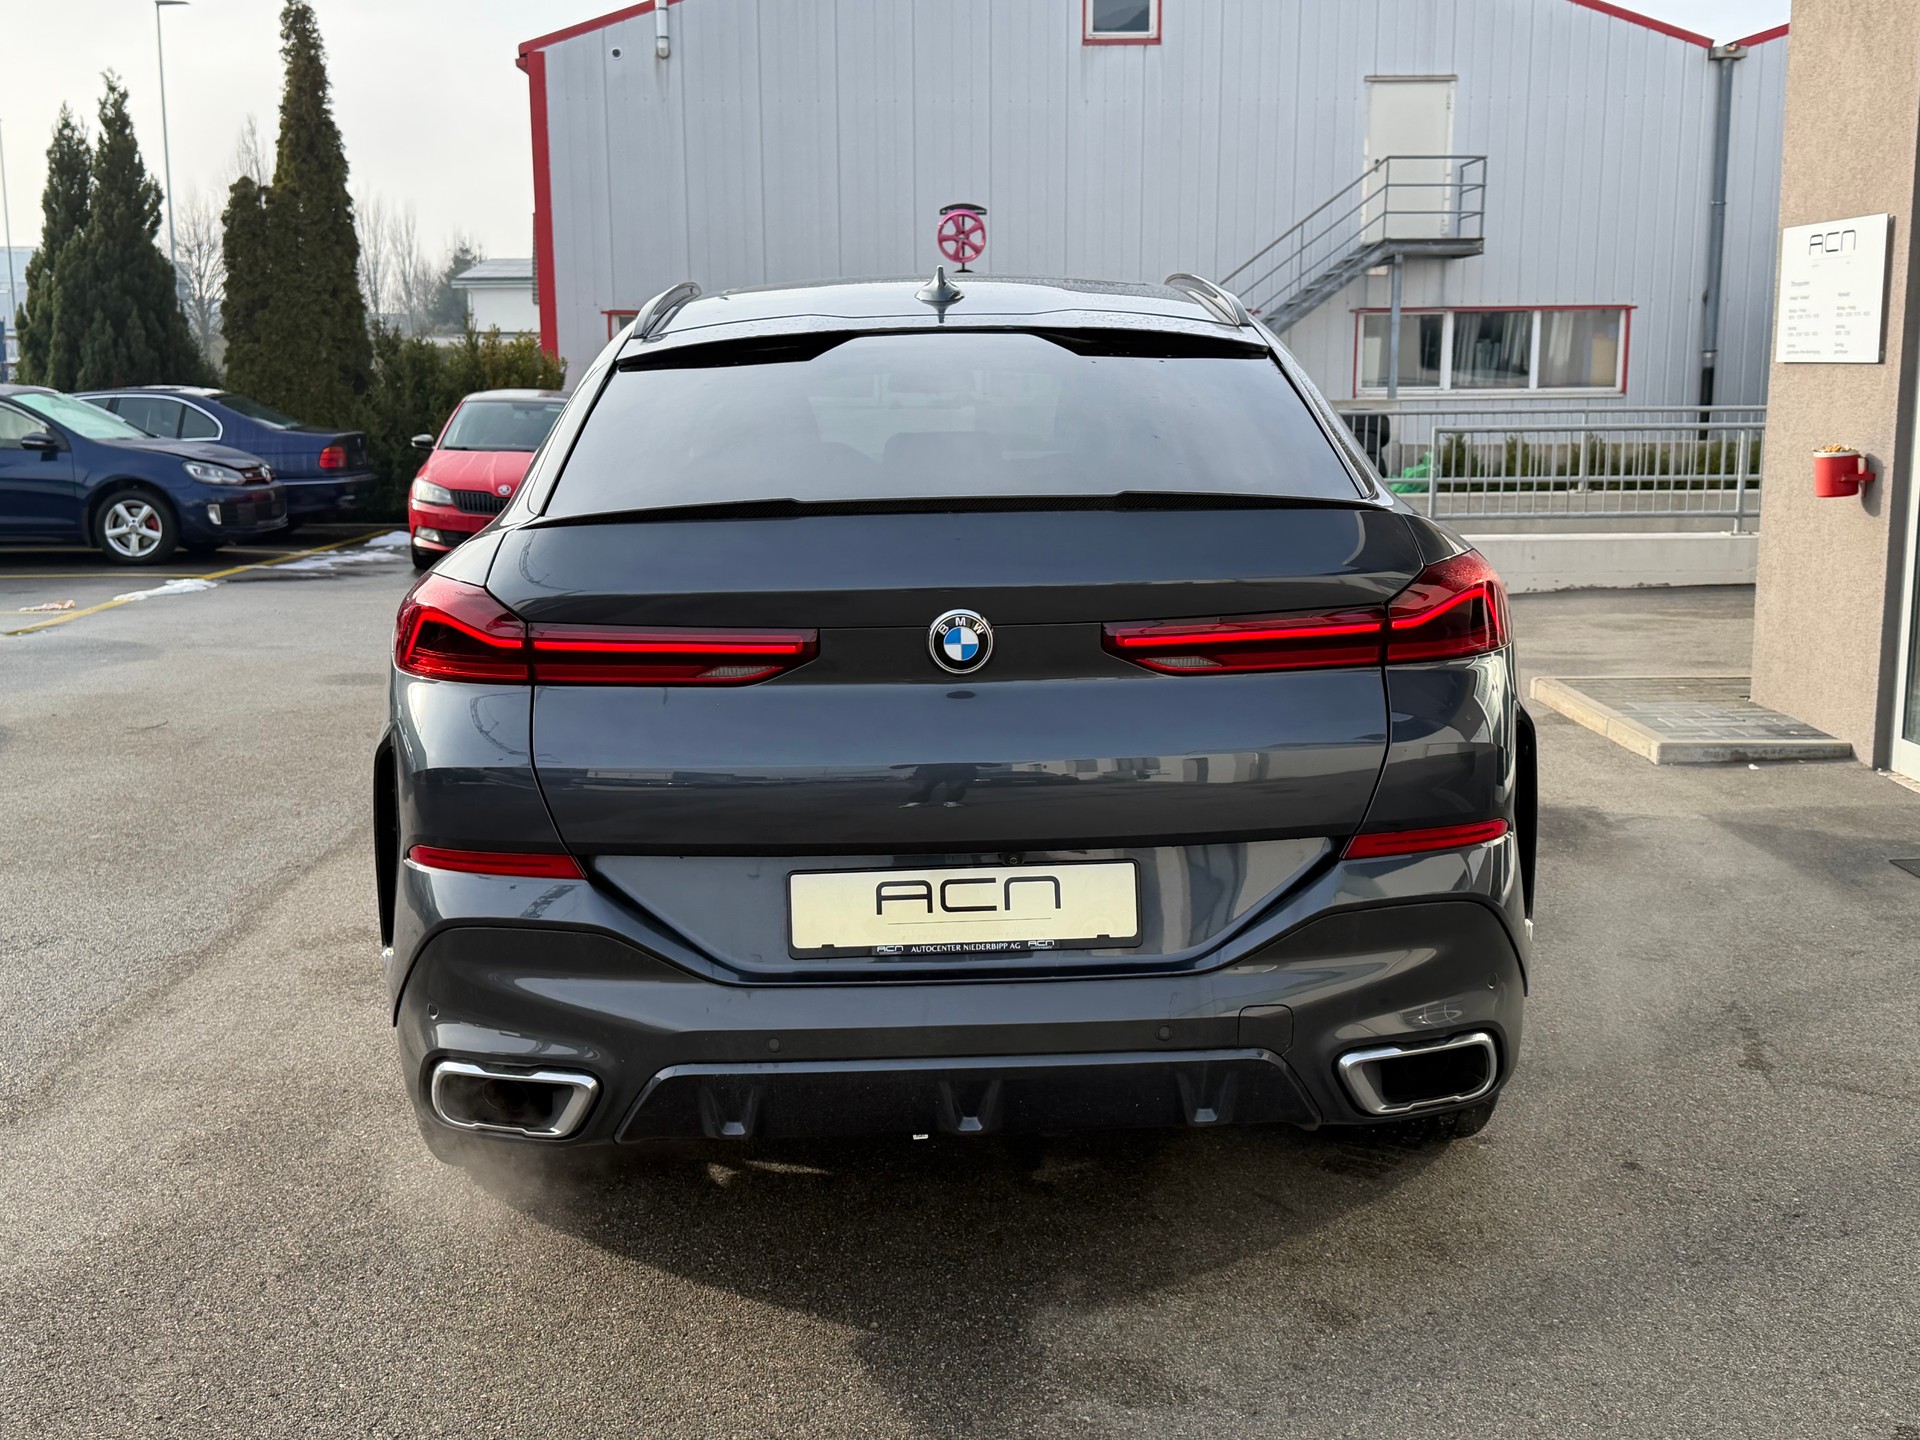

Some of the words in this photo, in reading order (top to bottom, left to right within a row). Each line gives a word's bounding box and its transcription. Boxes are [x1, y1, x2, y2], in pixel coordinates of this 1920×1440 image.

[937, 616, 985, 636] BMW
[876, 875, 1061, 915] ACN
[910, 944, 962, 953] AUTOCENTER
[963, 942, 1009, 951] NIEDERBIPP
[1010, 942, 1021, 950] AG
